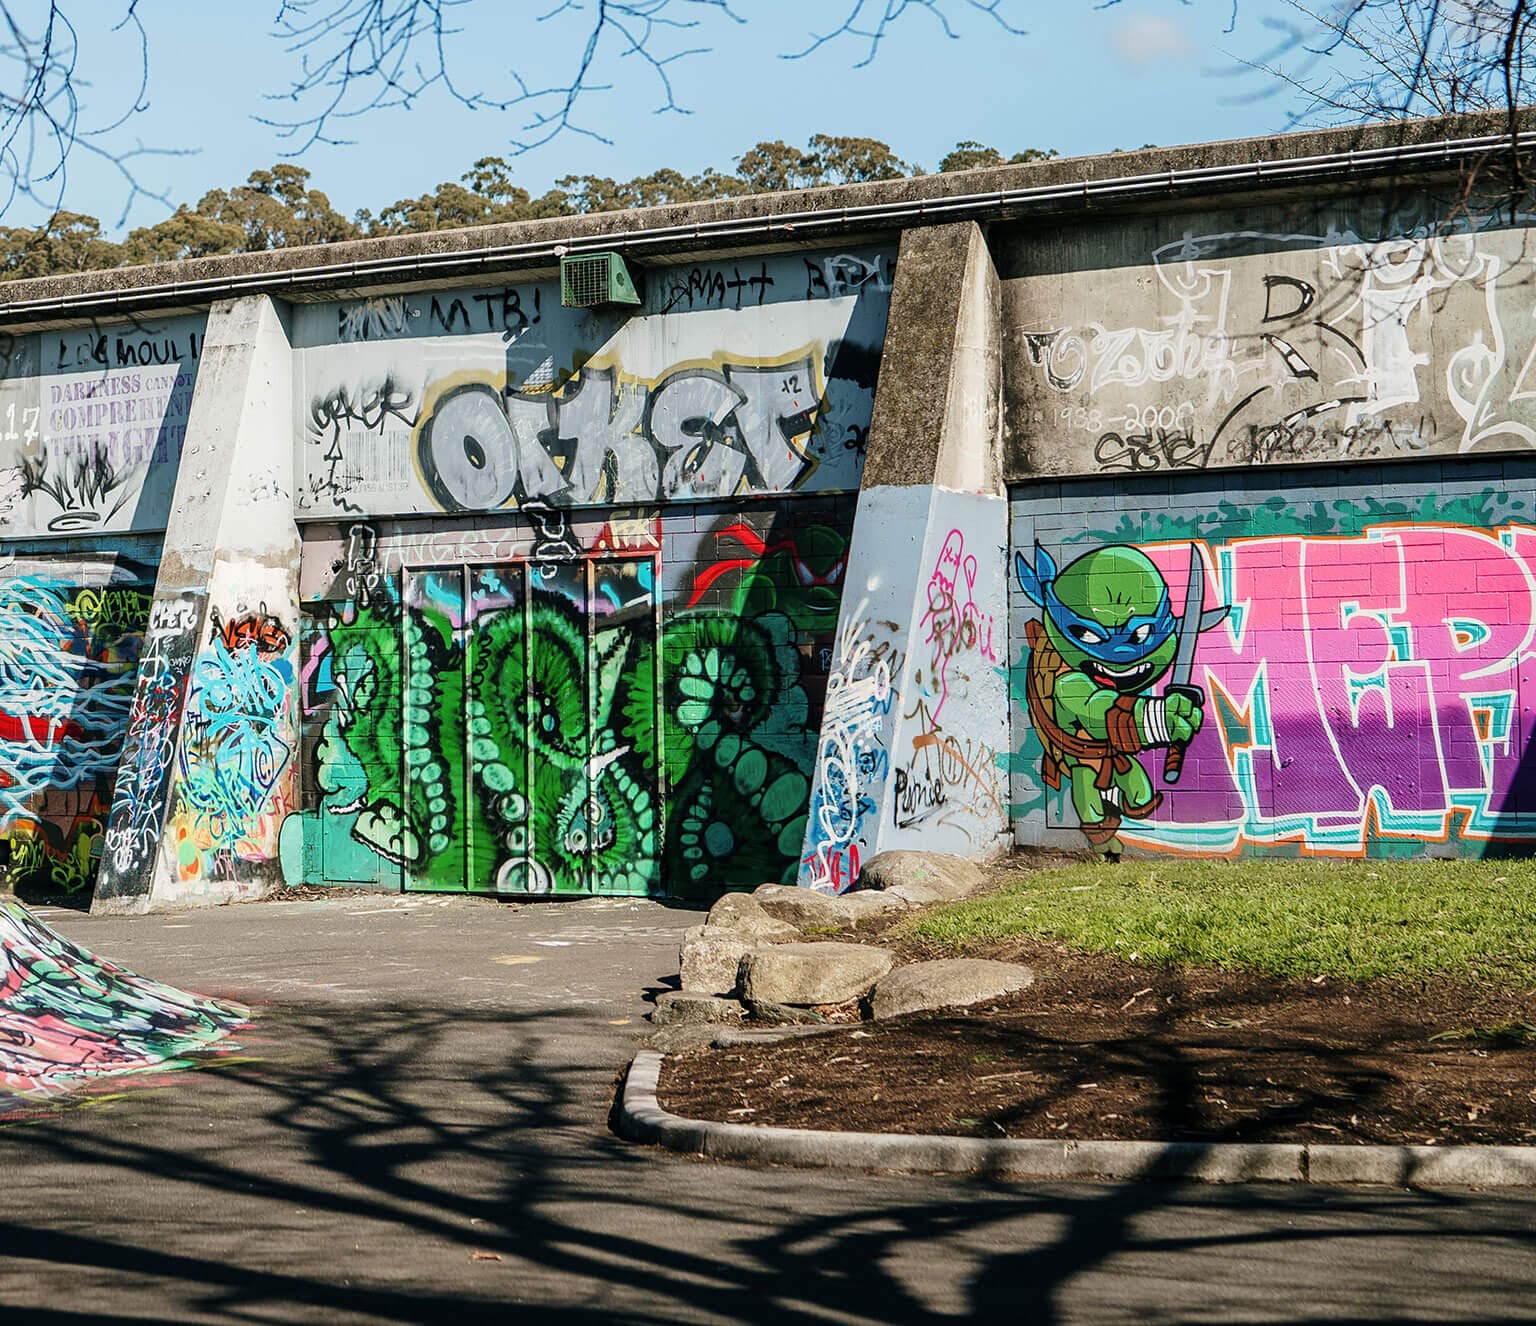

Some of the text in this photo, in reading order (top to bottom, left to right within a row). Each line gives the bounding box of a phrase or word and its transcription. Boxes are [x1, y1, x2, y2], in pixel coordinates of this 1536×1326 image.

[117, 333, 204, 366] MOULI
[51, 373, 193, 405] DARKNESS CANNOT
